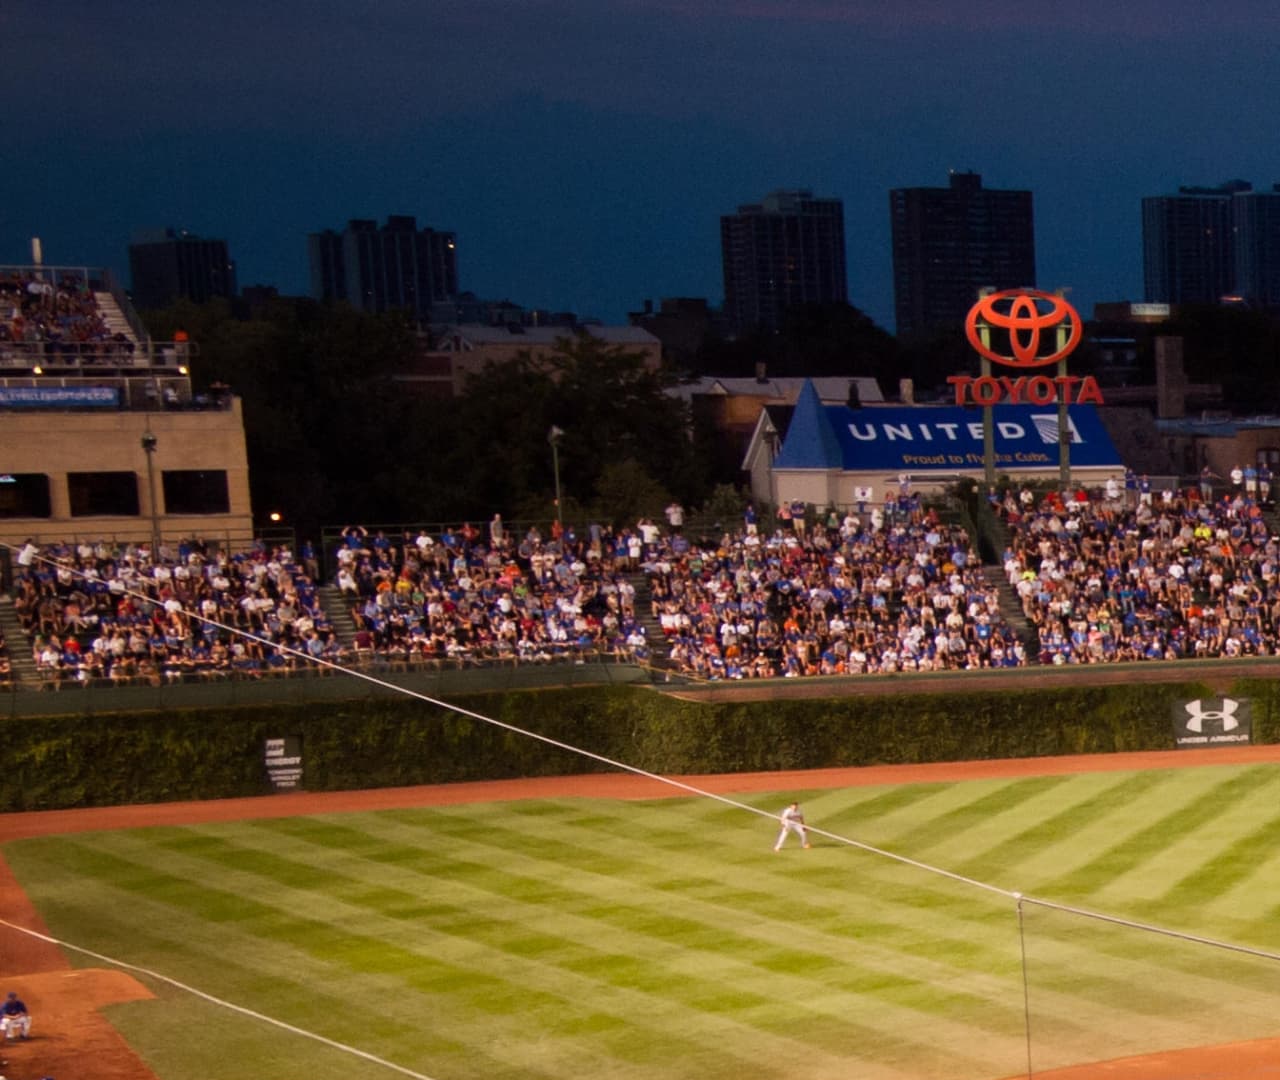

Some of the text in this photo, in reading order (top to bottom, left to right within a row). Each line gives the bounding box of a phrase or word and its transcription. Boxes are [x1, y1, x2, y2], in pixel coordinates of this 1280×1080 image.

[946, 376, 1104, 406] TOYOTA
[848, 423, 1026, 441] UNITED
[902, 453, 945, 466] Proud
[948, 453, 964, 465] to
[966, 452, 983, 466] fly
[1177, 734, 1249, 744] UNDER ARMOUR
[265, 757, 301, 766] ENERGY
